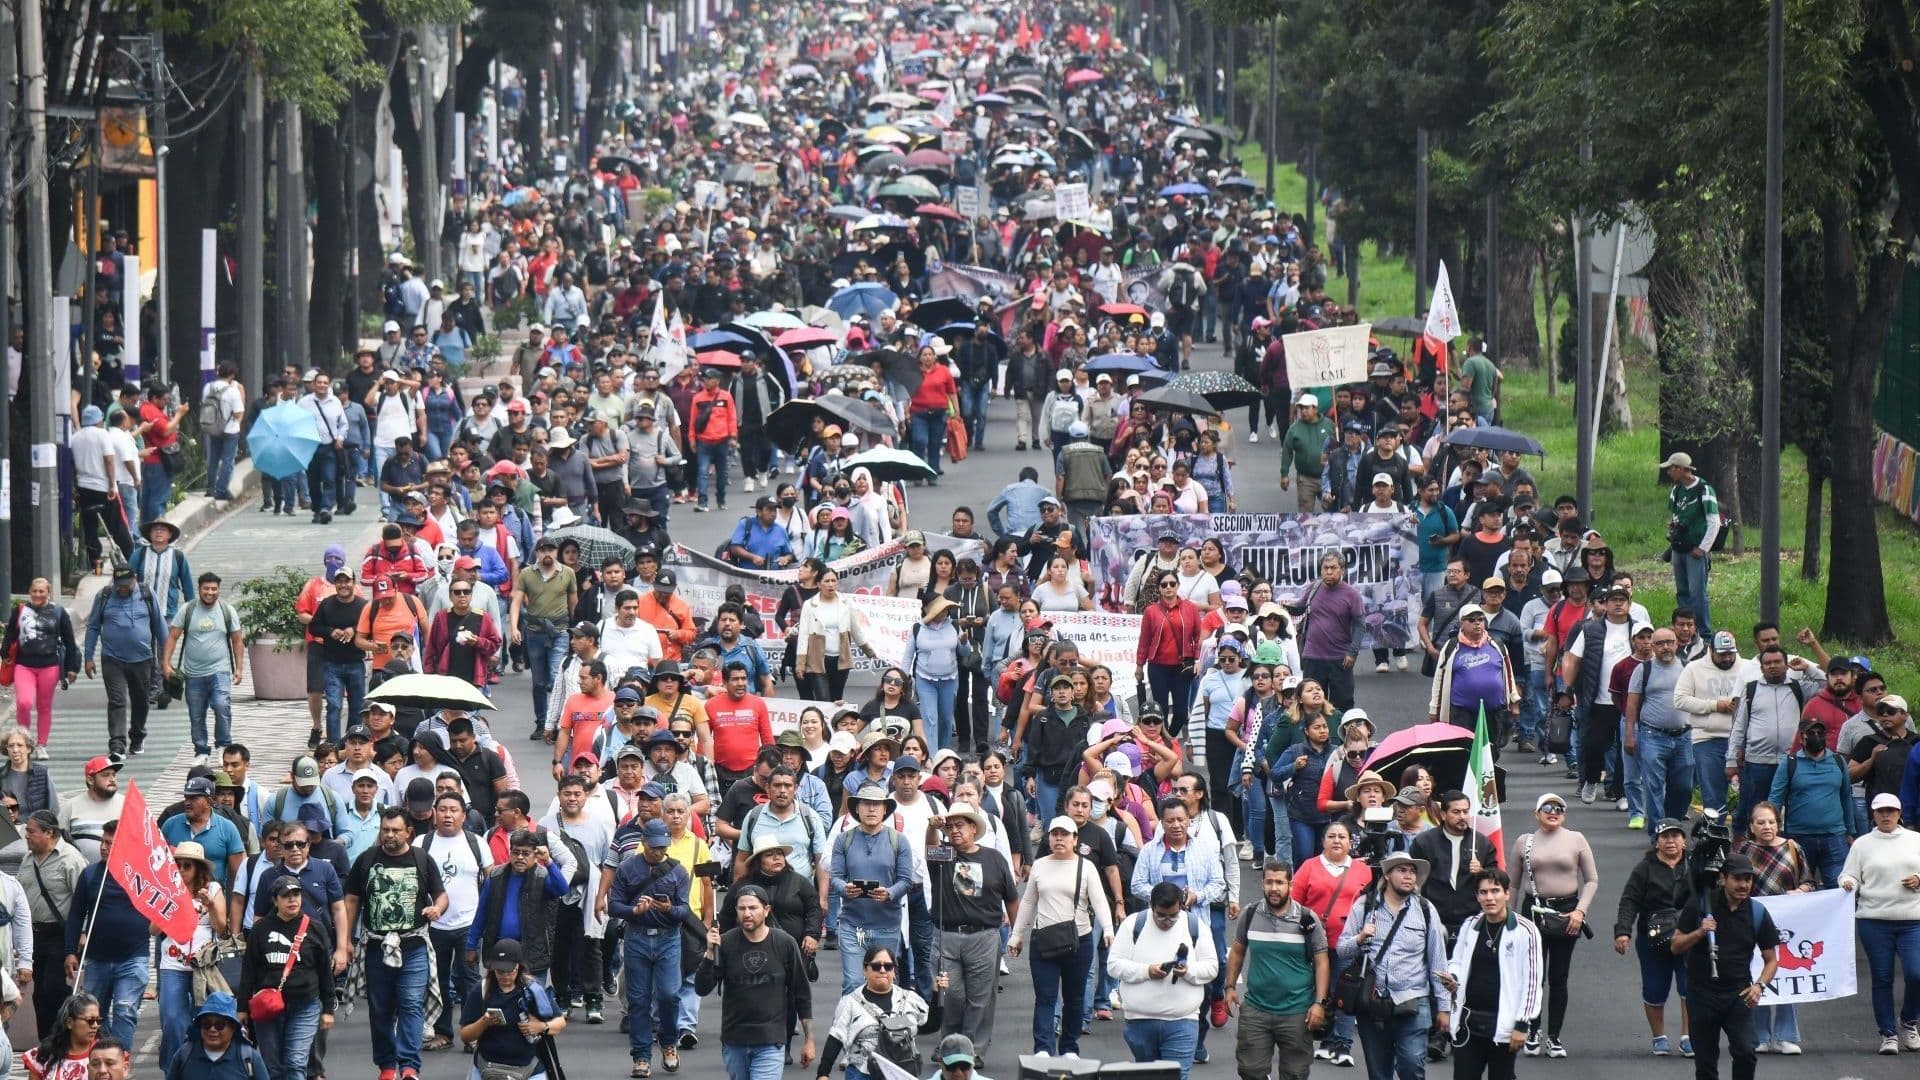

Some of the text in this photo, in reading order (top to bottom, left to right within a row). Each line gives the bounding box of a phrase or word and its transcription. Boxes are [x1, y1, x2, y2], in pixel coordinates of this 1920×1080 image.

[1242, 543, 1390, 587] HUAJUPAN
[1089, 632, 1109, 642] 401
[1760, 973, 1827, 997] NTE
